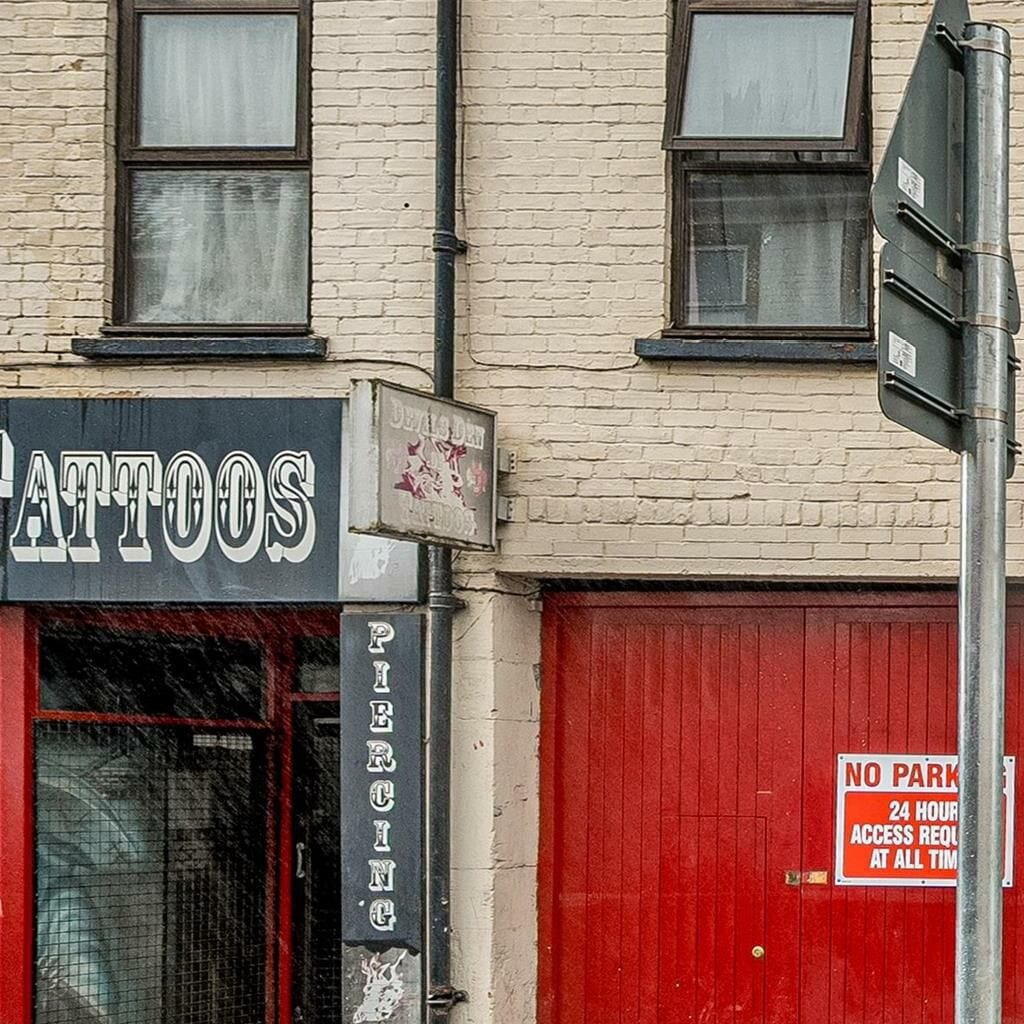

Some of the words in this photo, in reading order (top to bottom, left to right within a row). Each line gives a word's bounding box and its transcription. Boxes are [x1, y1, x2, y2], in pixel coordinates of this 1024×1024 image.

[366, 620, 397, 932] PIERCING
[845, 762, 882, 788] NO
[892, 763, 1006, 789] PARK
[889, 800, 911, 821] 24
[850, 824, 914, 845] ACCESS
[919, 825, 960, 848] REQU
[870, 849, 889, 869] AT
[893, 849, 923, 869] ALL
[928, 849, 960, 869] TIM
